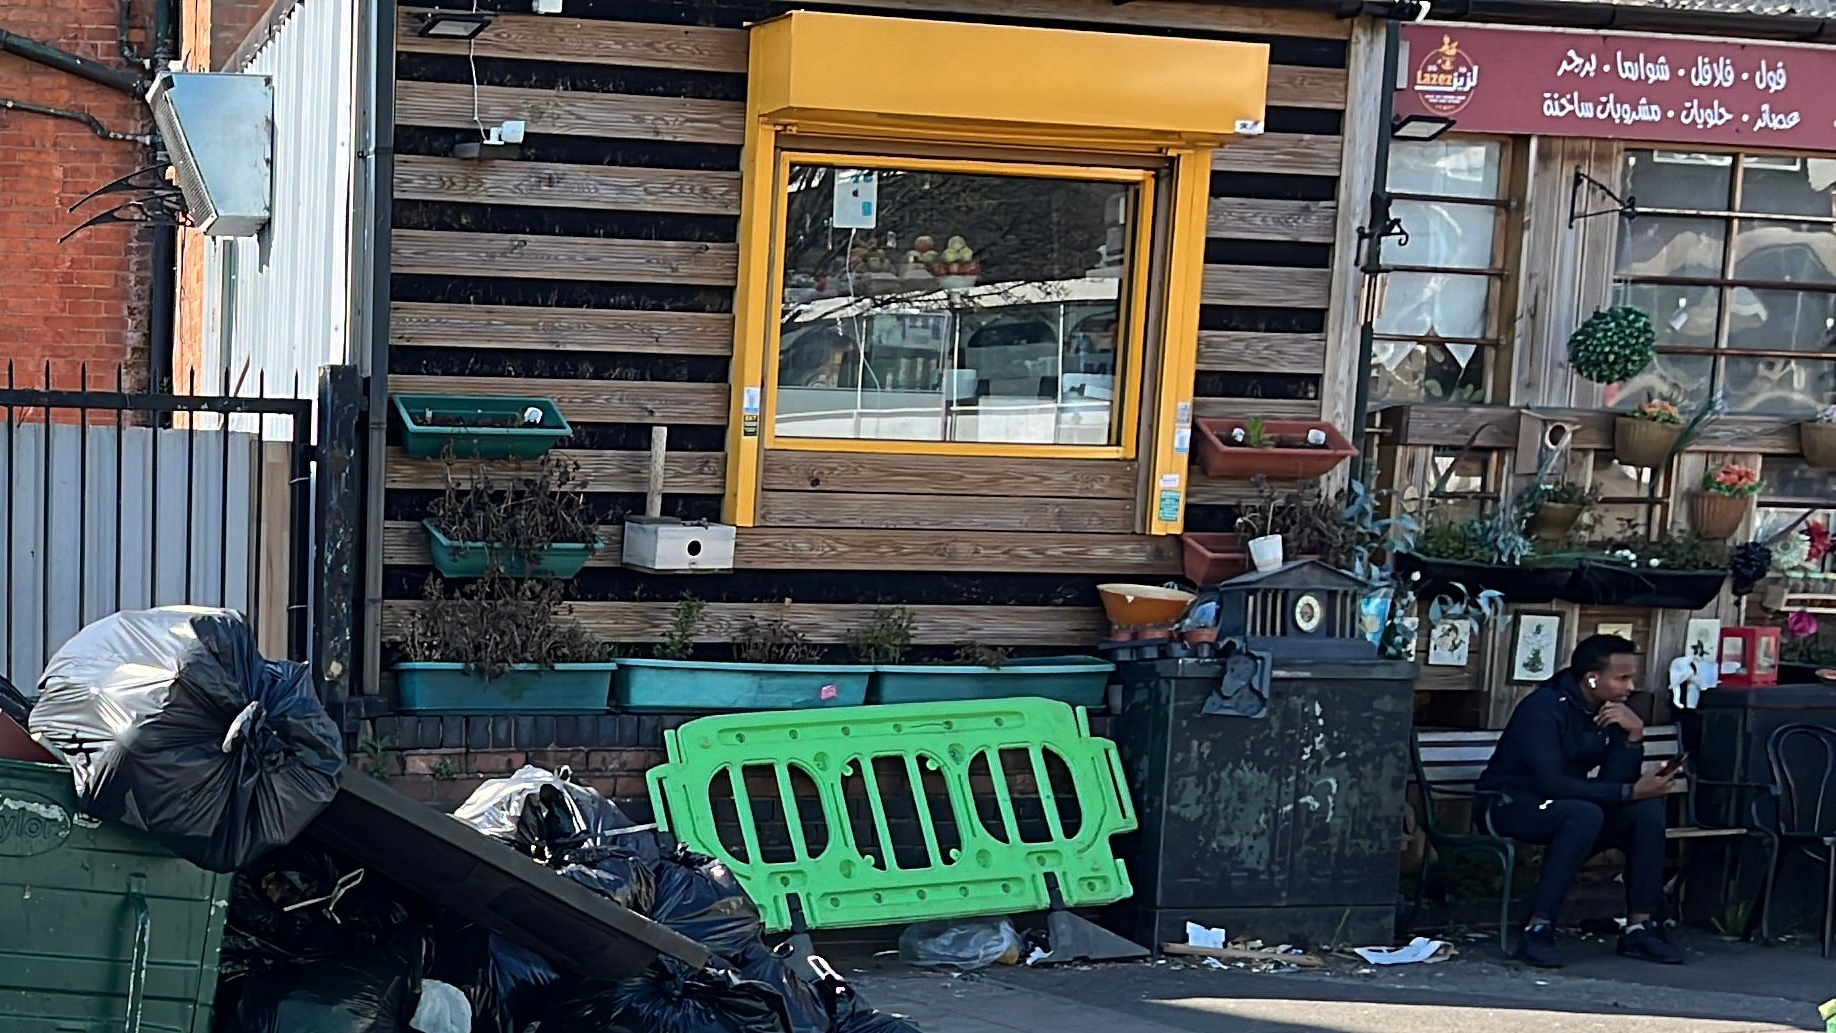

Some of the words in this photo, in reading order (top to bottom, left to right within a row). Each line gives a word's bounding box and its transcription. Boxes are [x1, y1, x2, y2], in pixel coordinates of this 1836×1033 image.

[1616, 50, 1671, 84] شوارما
[1690, 55, 1735, 88] فلافل
[1755, 58, 1787, 93] فول
[1543, 90, 1595, 118] ساخنة
[1596, 93, 1662, 125] مشروبات
[1680, 98, 1734, 129] حلويات
